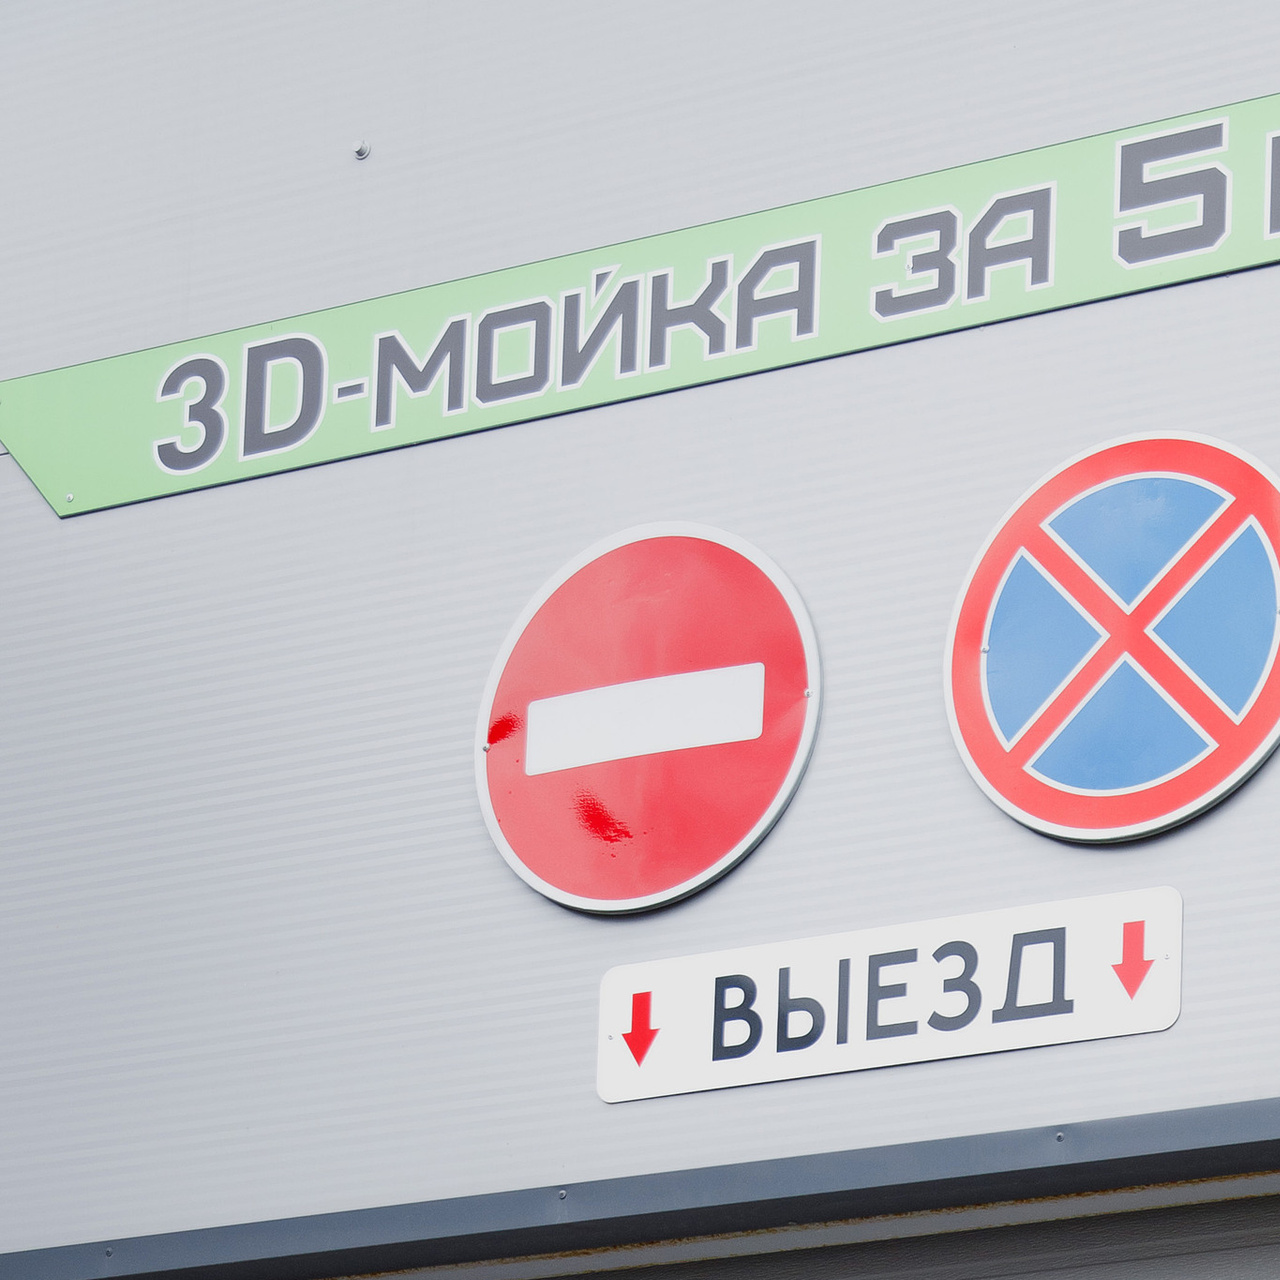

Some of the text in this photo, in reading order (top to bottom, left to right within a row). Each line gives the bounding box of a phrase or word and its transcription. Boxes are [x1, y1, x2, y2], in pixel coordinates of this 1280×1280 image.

[154, 238, 818, 472] 3D-МОЙКА
[873, 186, 1054, 318] ЗА
[1116, 124, 1228, 266] 5
[711, 926, 1075, 1062] ВЫЕЗД
